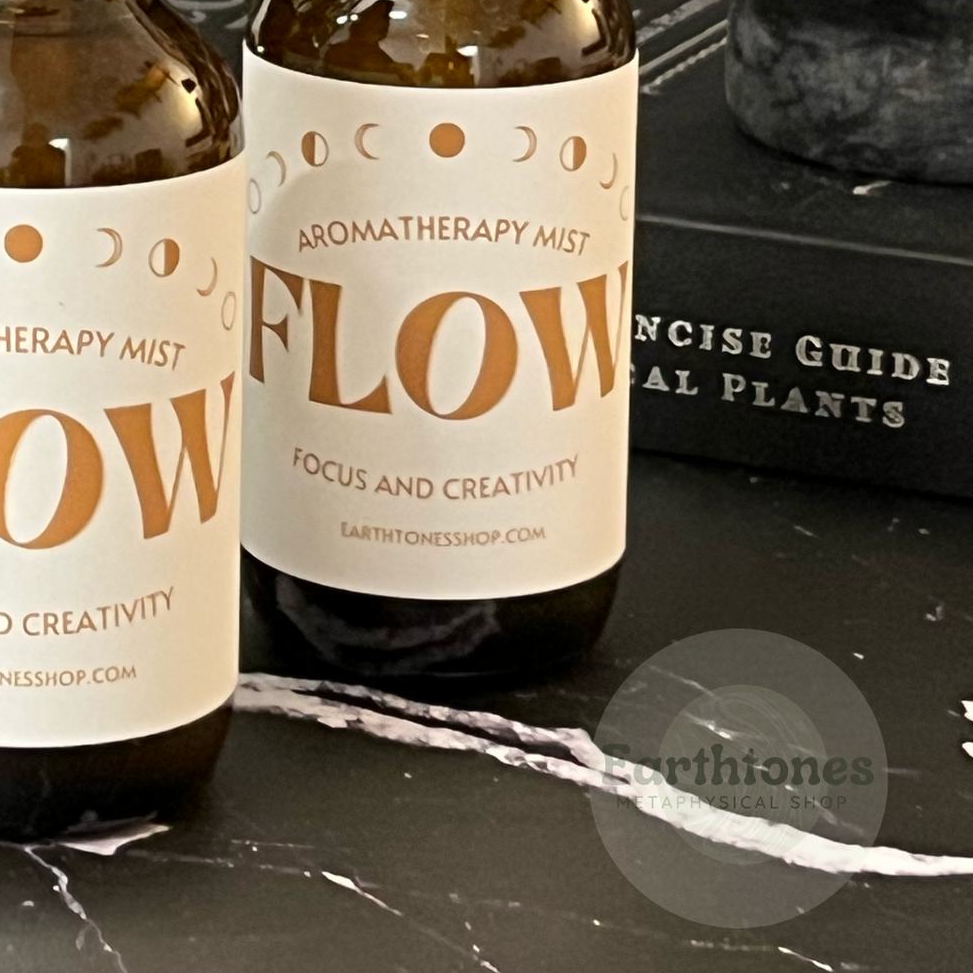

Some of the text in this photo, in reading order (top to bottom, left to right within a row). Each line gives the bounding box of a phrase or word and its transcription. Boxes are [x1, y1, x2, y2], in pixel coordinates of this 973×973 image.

[297, 215, 591, 257] AROMATHERAPY MIST
[118, 337, 187, 372] MIST
[249, 254, 629, 421] FLOW
[794, 334, 950, 386] GUIDE
[630, 362, 906, 429] AL PLANTS
[292, 446, 580, 502] FOCUS AND CREATIVITY
[340, 520, 547, 549] EARTHTONESSHOP.COM
[21, 586, 175, 637] CREATIVITY
